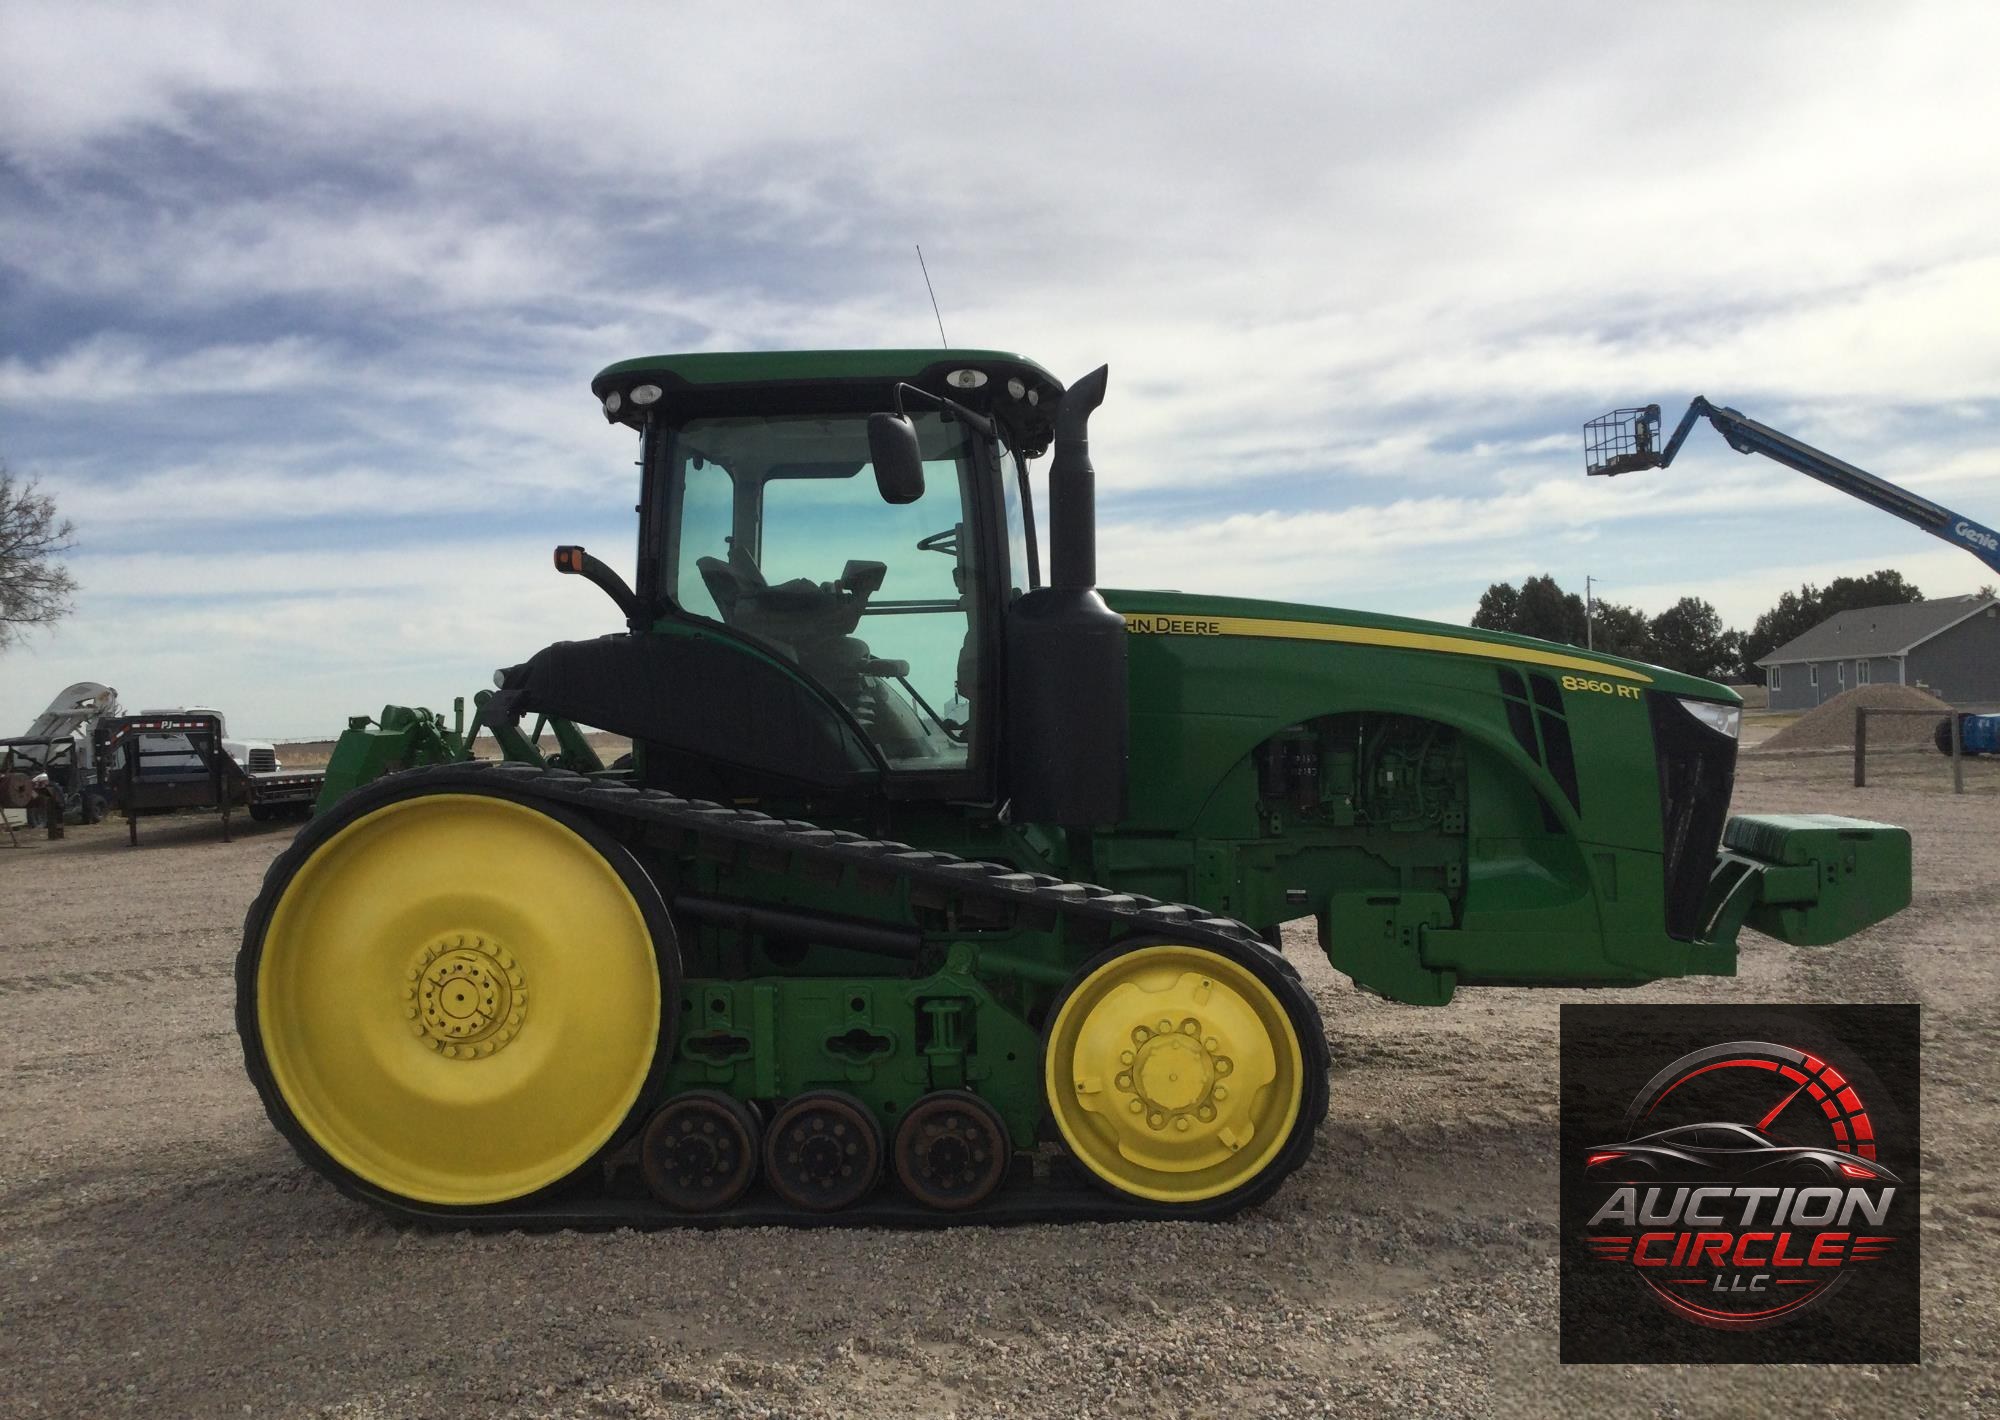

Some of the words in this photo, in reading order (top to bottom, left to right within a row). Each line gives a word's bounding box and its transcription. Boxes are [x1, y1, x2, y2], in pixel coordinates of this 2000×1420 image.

[1955, 521, 1999, 551] Genie
[1156, 617, 1220, 633] DEERE
[1561, 675, 1613, 694] 8360
[1616, 684, 1641, 699] RT
[160, 720, 173, 729] PJ
